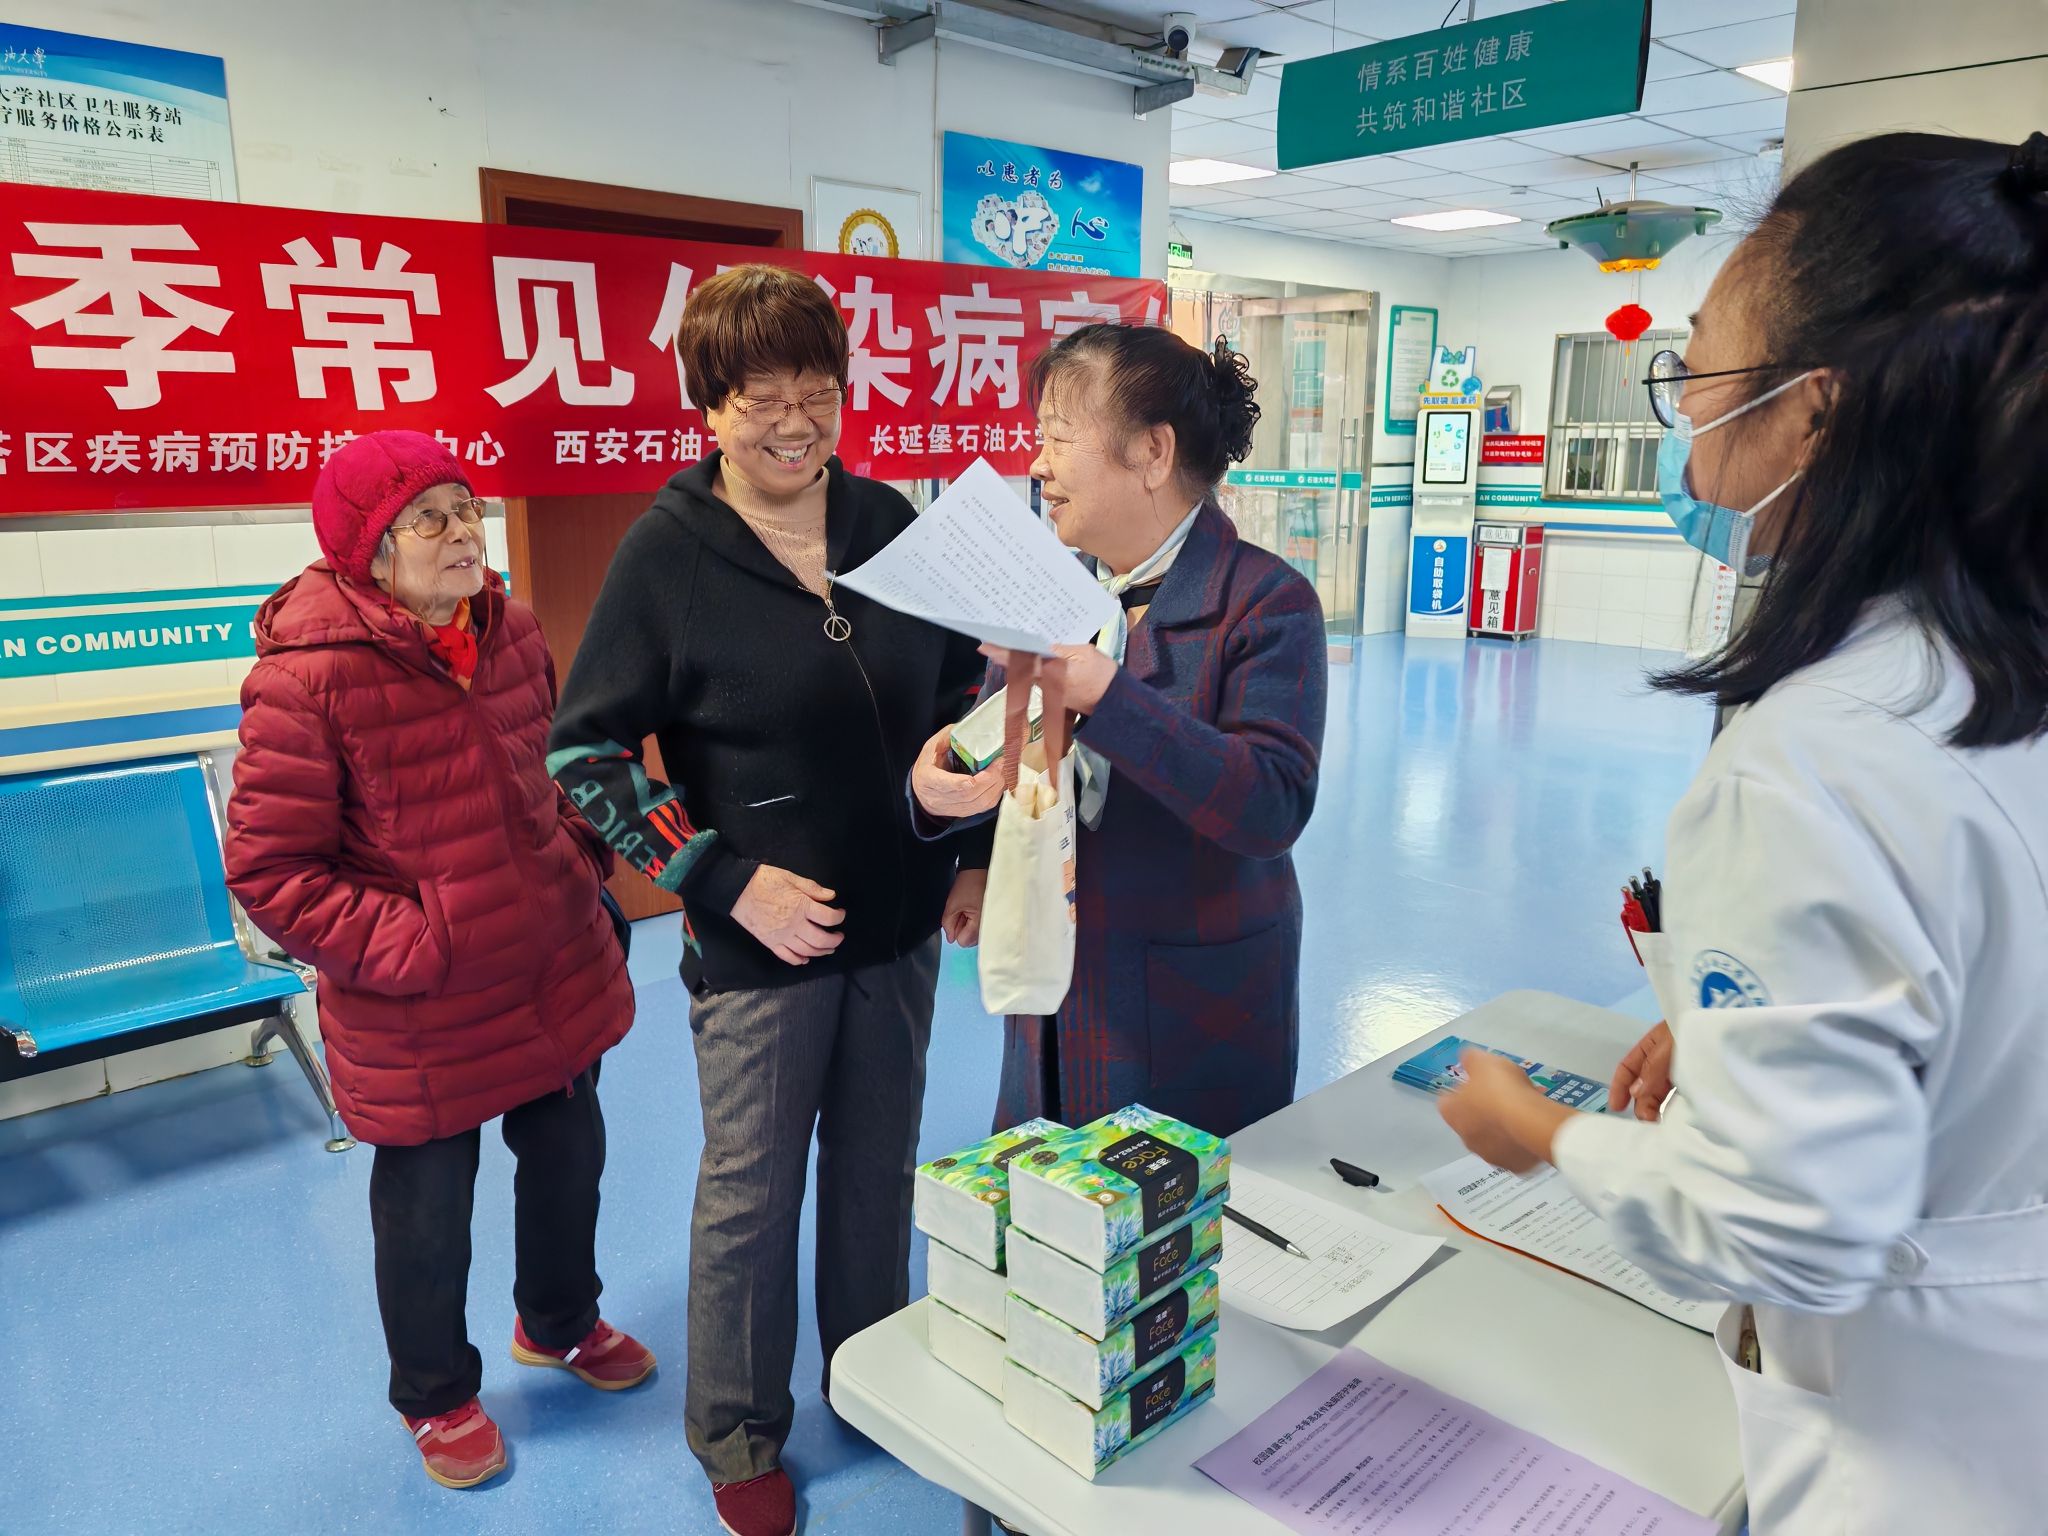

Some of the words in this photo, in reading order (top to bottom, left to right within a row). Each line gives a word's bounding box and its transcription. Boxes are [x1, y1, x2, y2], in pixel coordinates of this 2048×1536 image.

[1357, 30, 1534, 94] 情系百姓健康
[1356, 77, 1528, 137] 共筑和谐社区
[976, 160, 1064, 191] 以患者为
[1070, 207, 1110, 241] 心
[553, 427, 718, 464] 西安石油
[1491, 494, 1539, 502] COMMUNITY
[36, 622, 233, 655] COMMUNITY
[1122, 1146, 1169, 1169] Face
[1157, 1185, 1184, 1208] Face
[1153, 1249, 1179, 1272] Face
[1149, 1318, 1174, 1341] Face
[1145, 1387, 1171, 1410] Face
